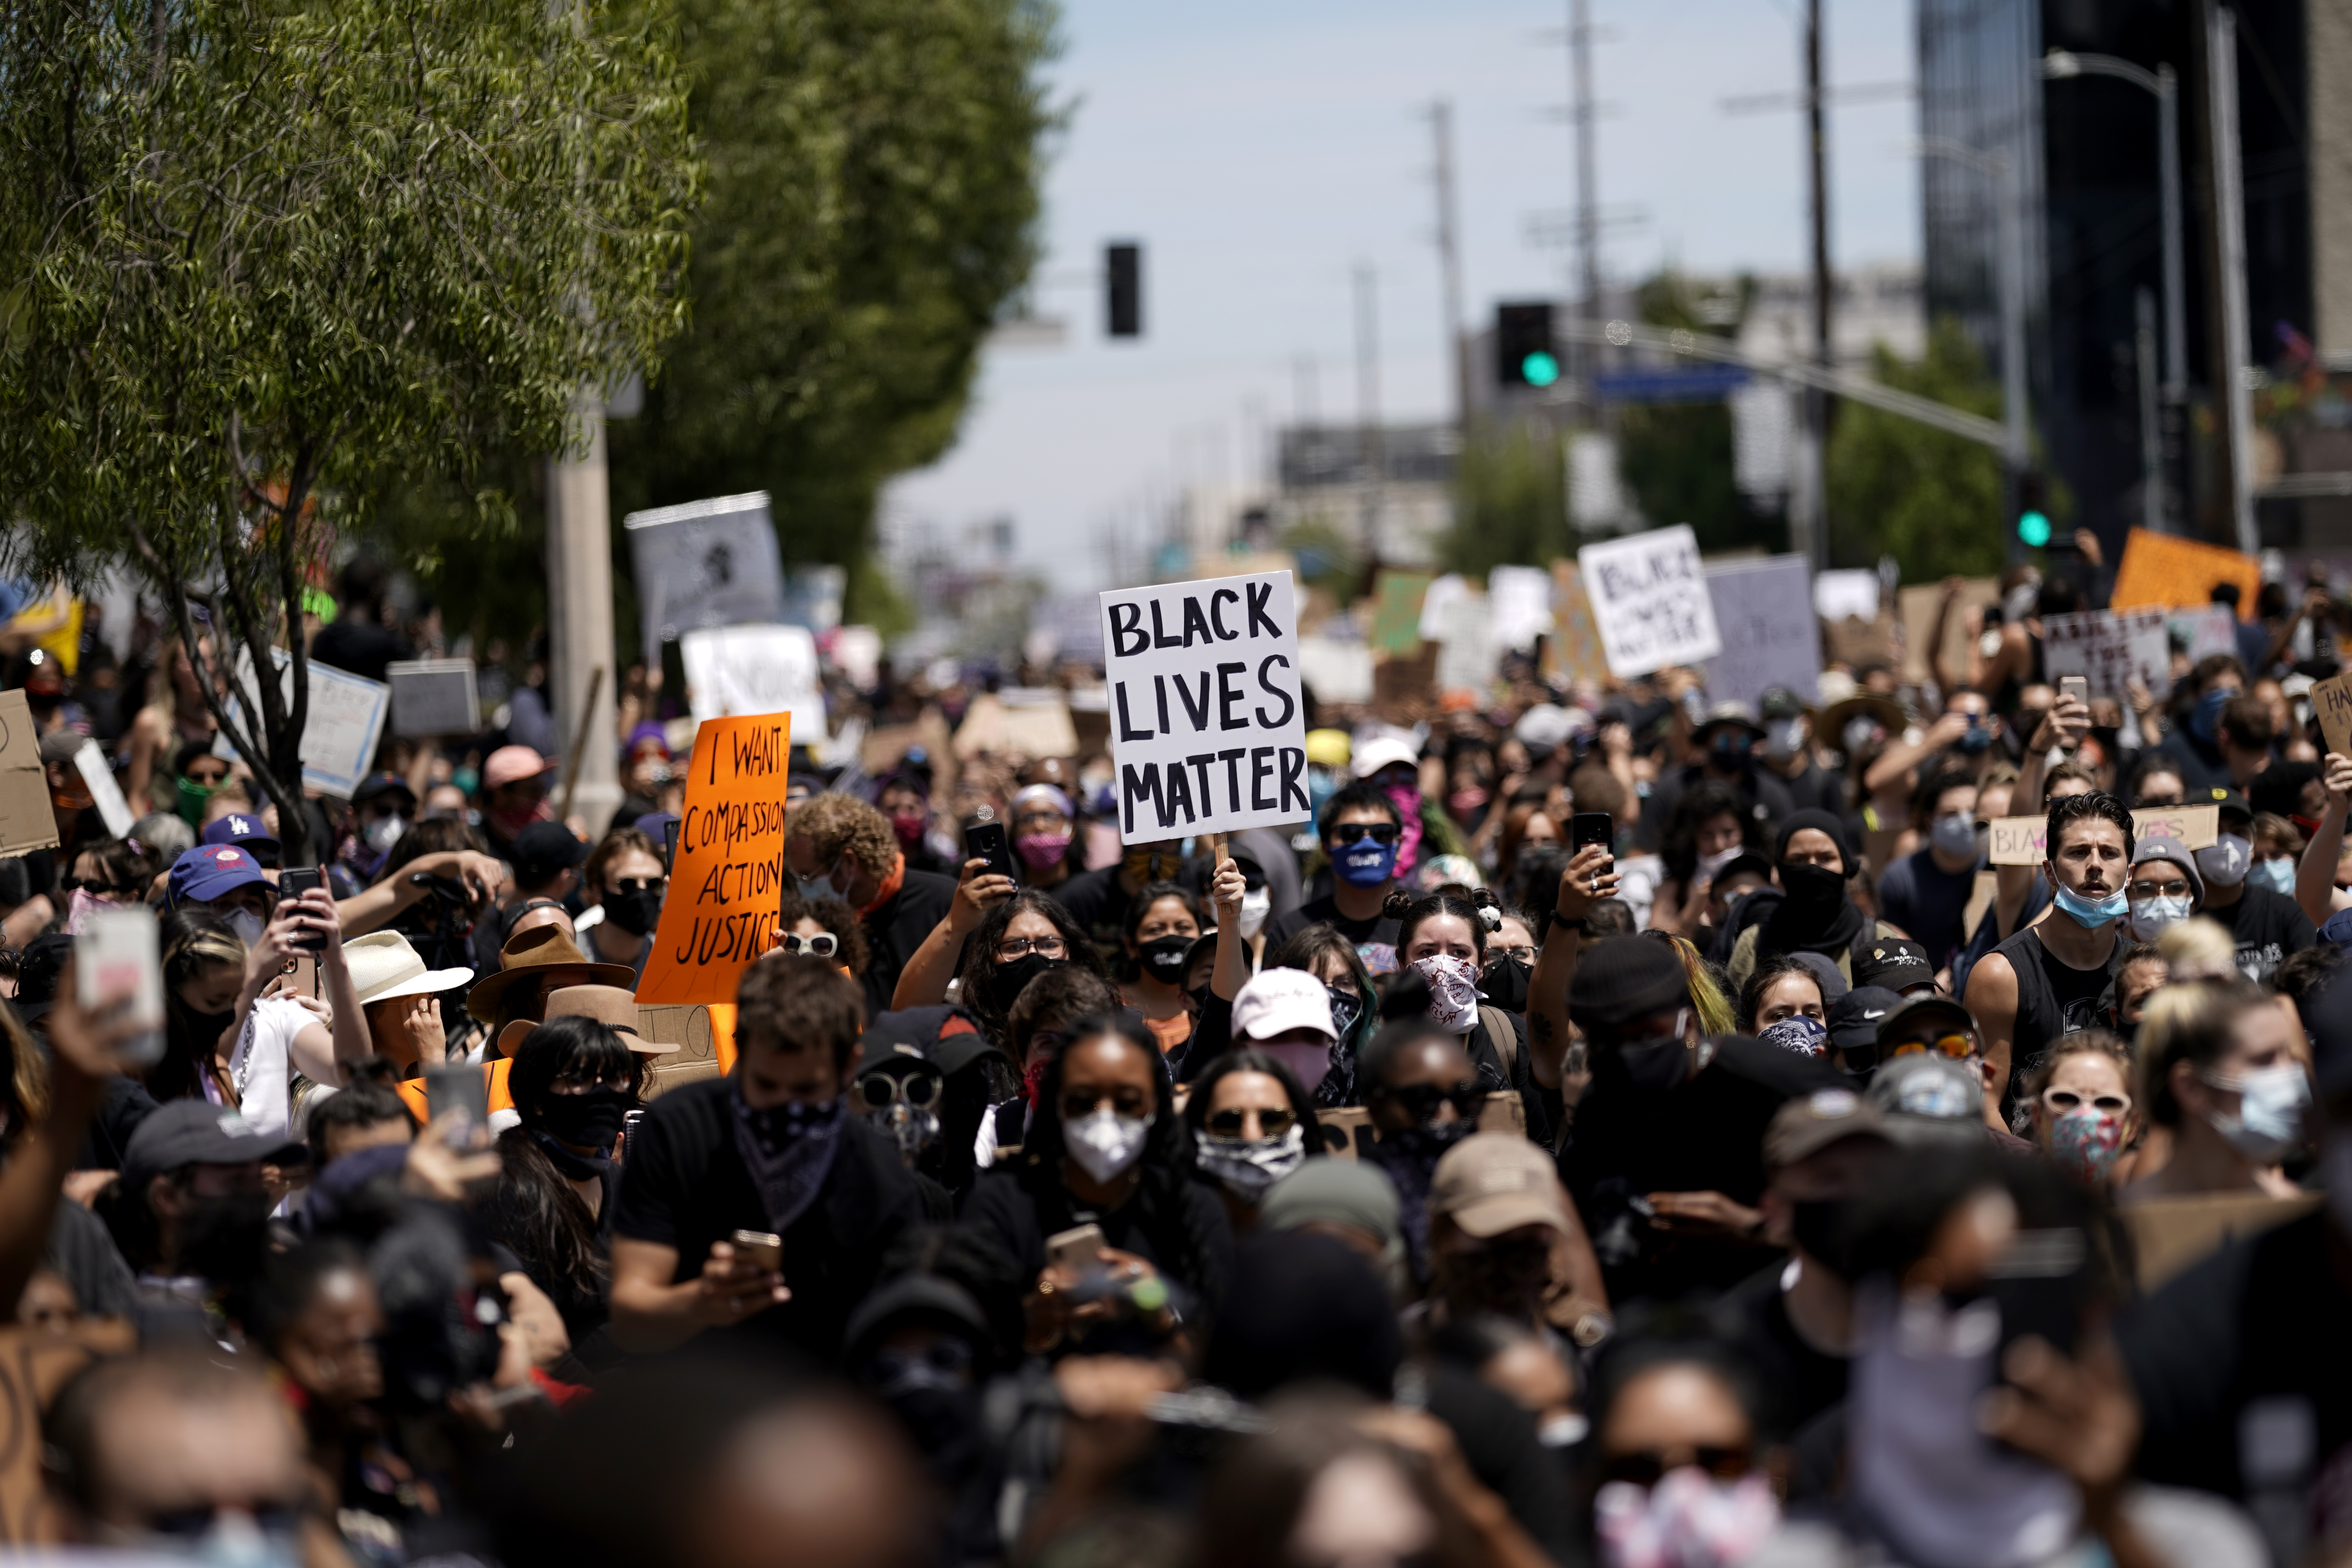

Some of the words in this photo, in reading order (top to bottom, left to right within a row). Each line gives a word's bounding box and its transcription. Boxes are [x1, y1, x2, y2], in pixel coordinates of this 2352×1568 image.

[1108, 582, 1282, 657] BLACK
[1115, 654, 1294, 742] LIVES
[710, 732, 719, 786] I
[733, 724, 781, 779] WANT
[1122, 746, 1311, 834] MATTER
[227, 815, 250, 835] LA
[215, 859, 248, 871] GIANTS
[697, 852, 781, 905] ACTION
[676, 910, 778, 966] JUSTICE
